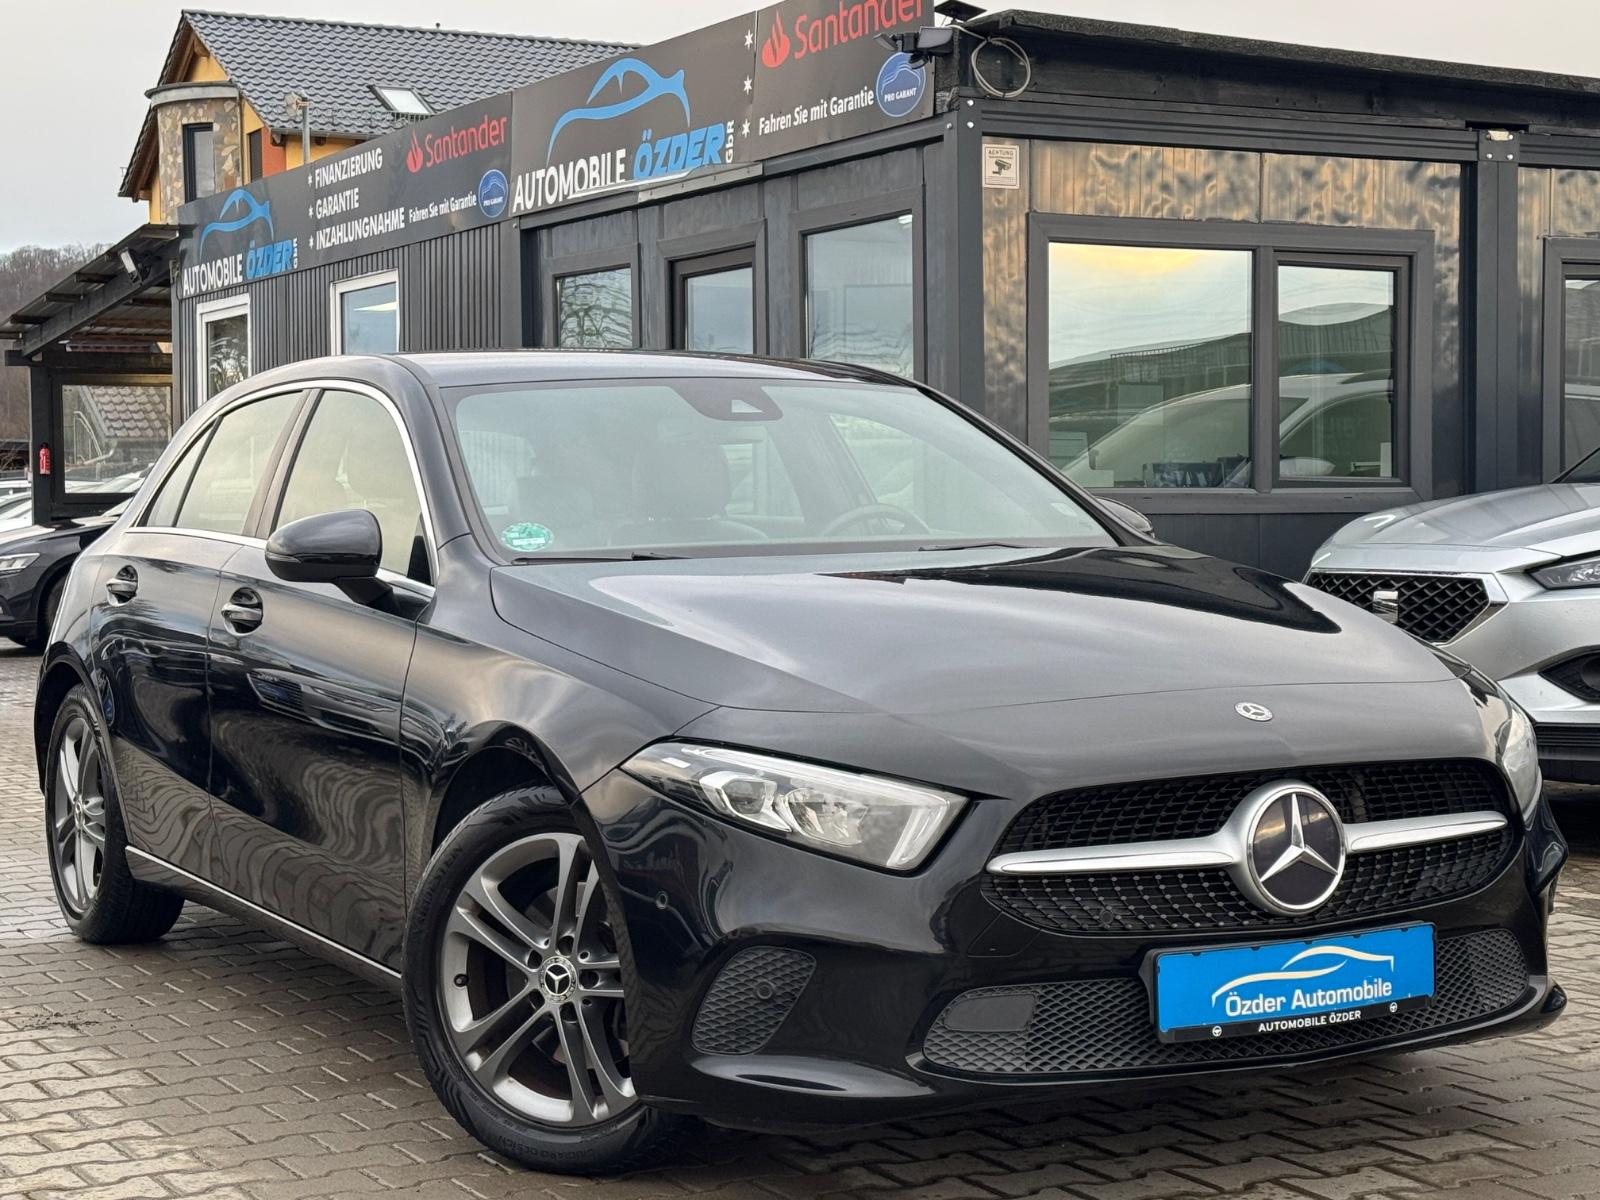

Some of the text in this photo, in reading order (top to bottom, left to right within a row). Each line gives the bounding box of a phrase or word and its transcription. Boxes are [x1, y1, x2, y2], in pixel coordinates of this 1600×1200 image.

[759, 86, 875, 136] Fahren Sie mit Garantie
[884, 87, 917, 102] PRO GARANT
[425, 114, 508, 168] Santander
[725, 119, 735, 163] GbR
[315, 147, 383, 189] FINANZIERUNG
[512, 128, 725, 213] AUTOMOBILE ÖZDER
[316, 187, 360, 219] GARANTIE
[409, 206, 429, 223] Fahren
[429, 202, 439, 218] Sie
[439, 198, 450, 214] mit
[450, 190, 477, 212] Garantie
[316, 207, 406, 250] INZAHLUNGNAHME
[183, 240, 293, 296] AUTOMOBILE ÖZDER
[1225, 978, 1393, 1016] Özder Automobile
[1258, 1010, 1362, 1032] AUTOMOBILE ÖZDER
